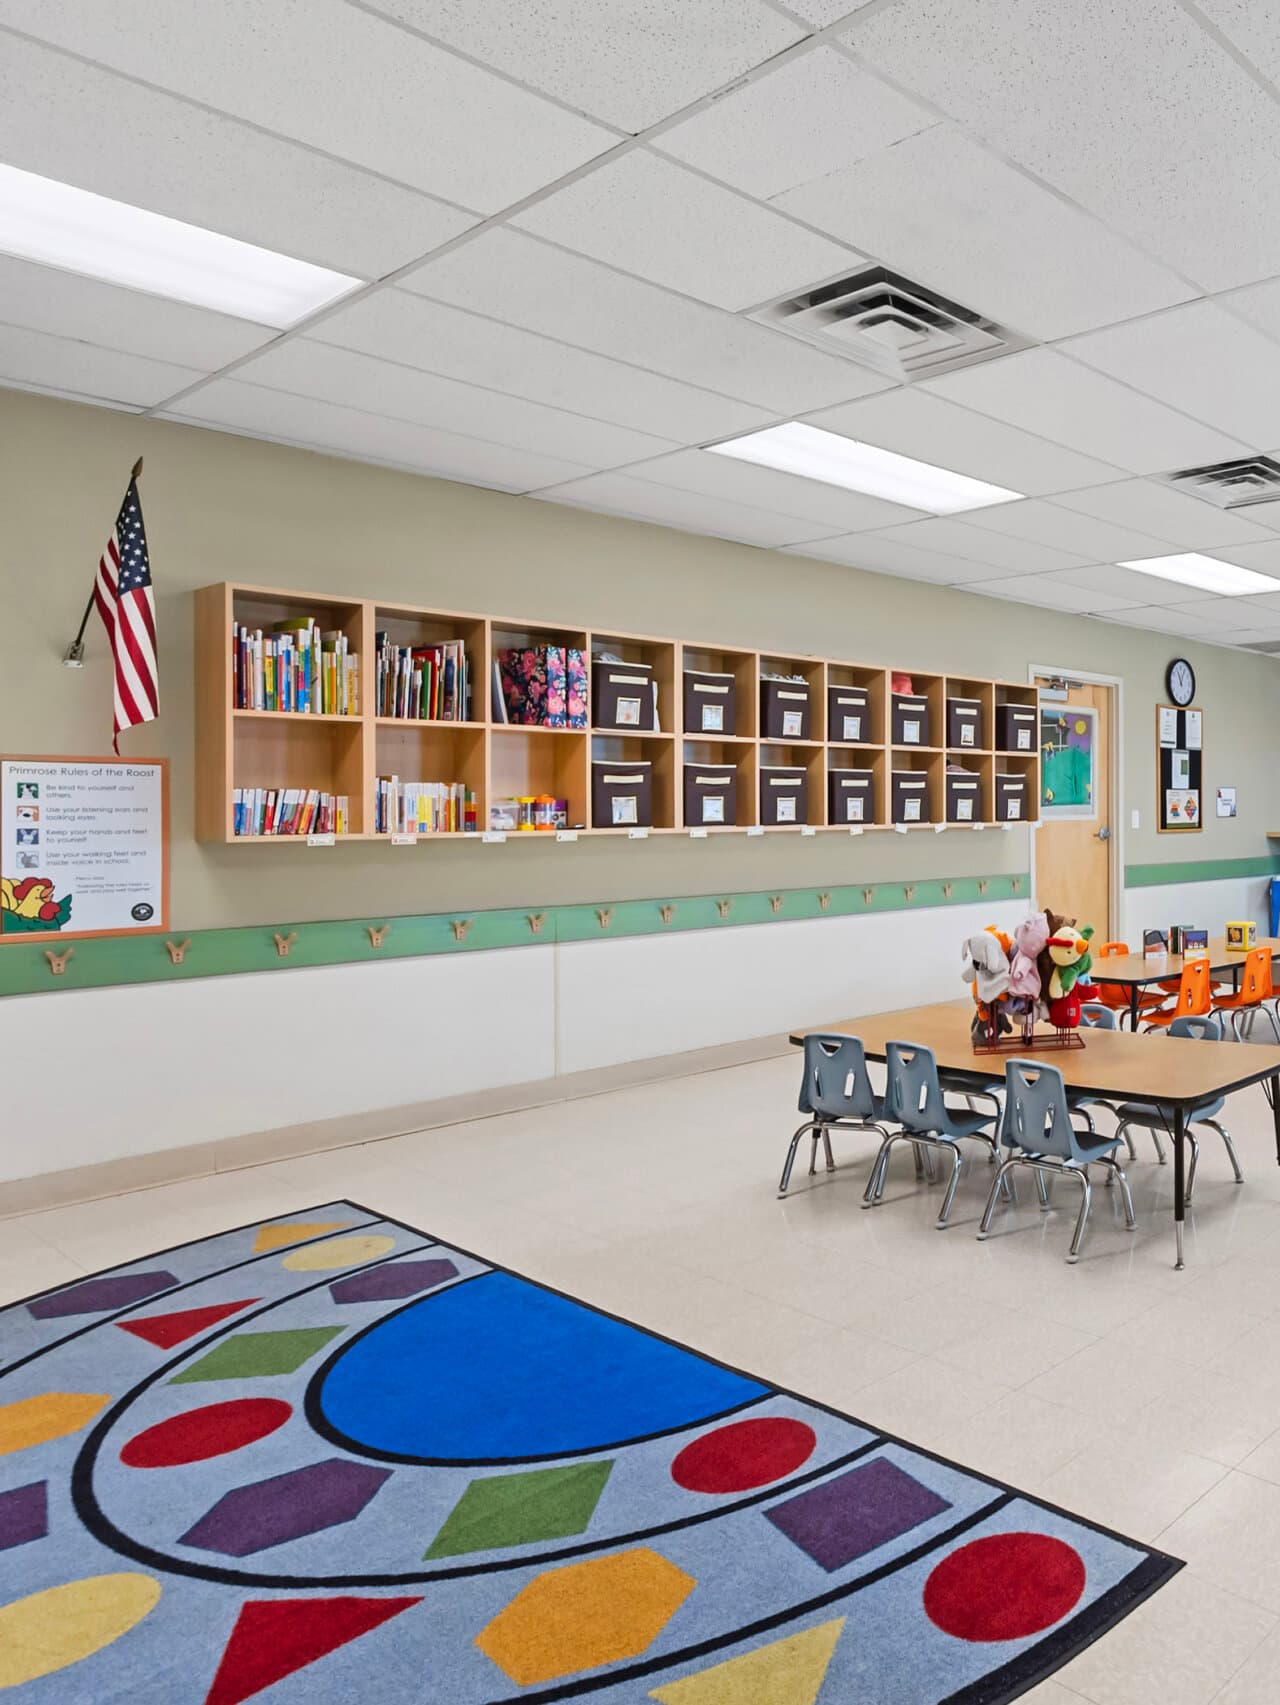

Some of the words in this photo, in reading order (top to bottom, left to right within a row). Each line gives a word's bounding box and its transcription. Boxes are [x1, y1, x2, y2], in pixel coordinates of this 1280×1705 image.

[9, 766, 57, 776] Primrose
[60, 767, 89, 776] Rules
[91, 767, 103, 776] of
[106, 768, 123, 777] the
[126, 768, 155, 777] Roost
[88, 784, 117, 793] yourself
[62, 807, 80, 815] your
[82, 806, 113, 815] listening
[46, 814, 76, 822] looking
[46, 828, 67, 837] Keep
[70, 829, 87, 837] your
[82, 851, 112, 859] walking
